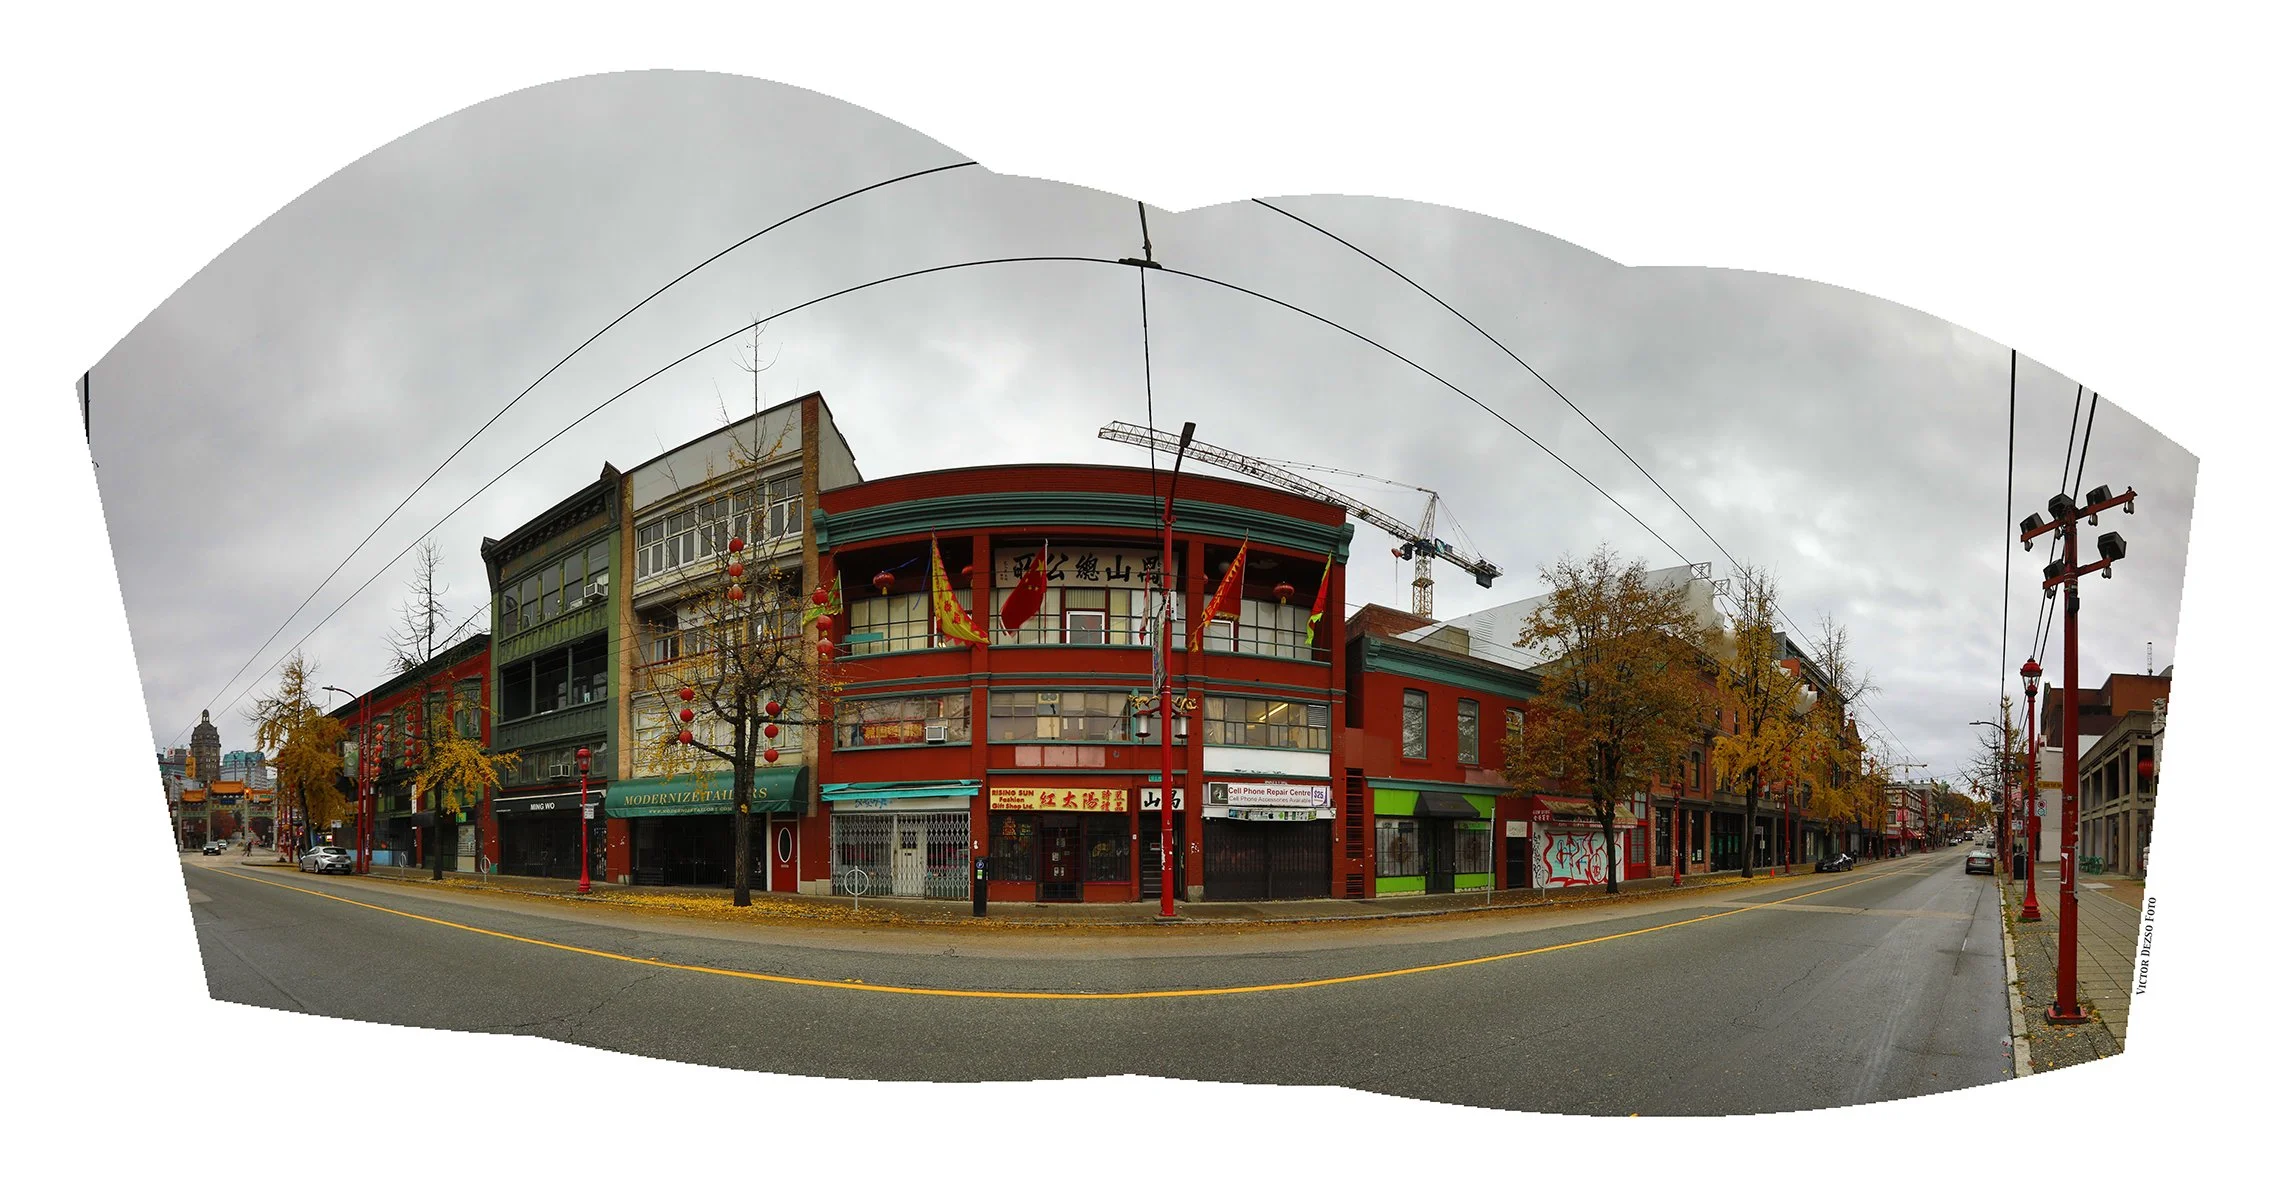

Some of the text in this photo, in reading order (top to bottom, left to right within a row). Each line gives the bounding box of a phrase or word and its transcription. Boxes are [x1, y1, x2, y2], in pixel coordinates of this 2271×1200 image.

[624, 791, 700, 806] MODERNIZE
[705, 787, 768, 801] TAILRS
[1266, 789, 1288, 797] Repair
[1313, 790, 1324, 799] $25
[1039, 790, 1099, 809] 紅太陽
[530, 802, 555, 811] MING WO
